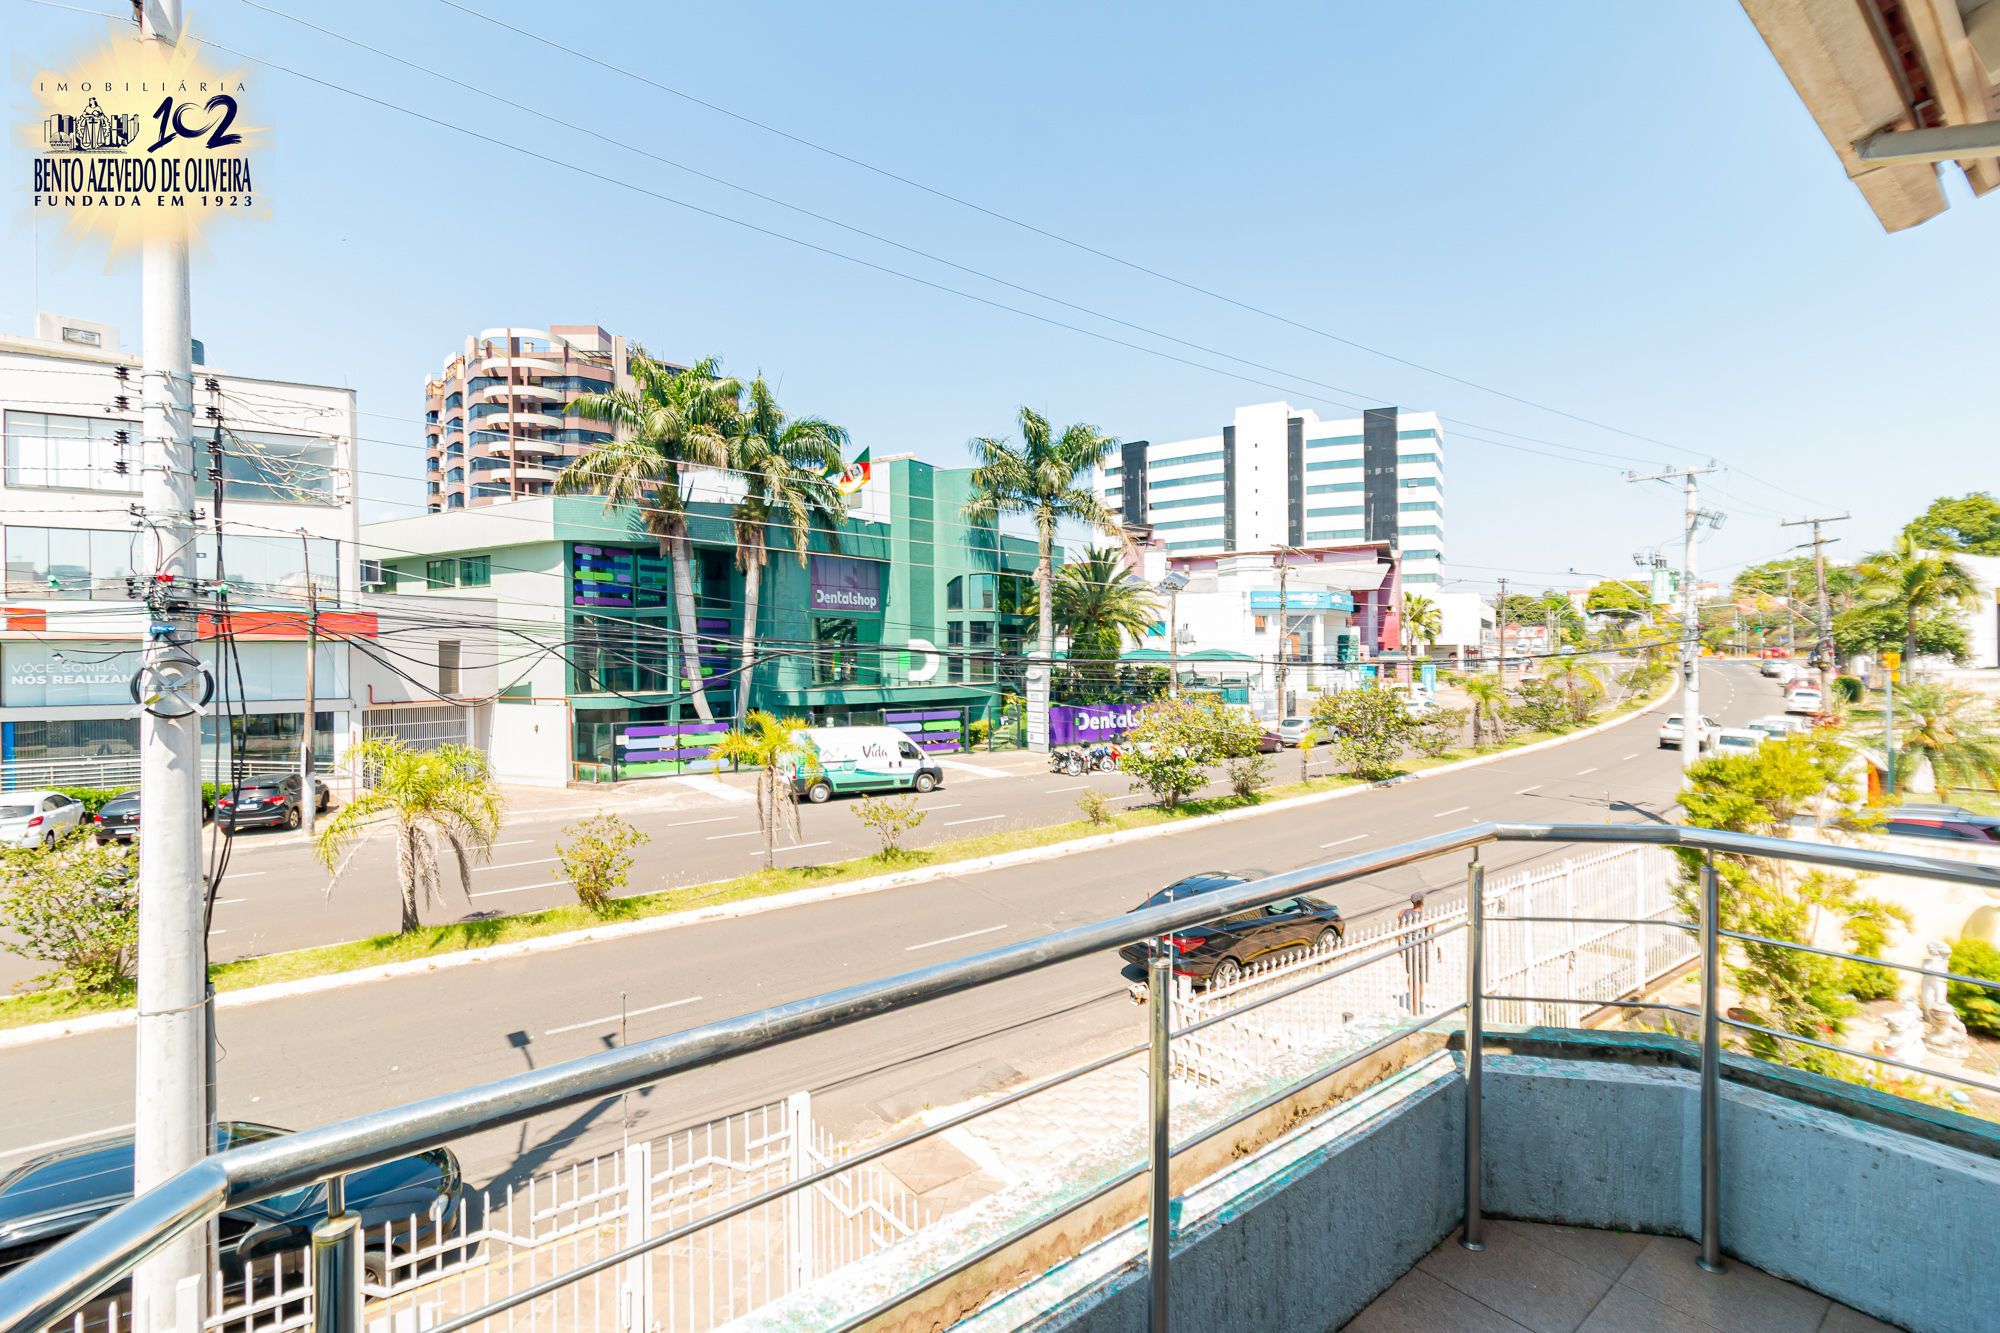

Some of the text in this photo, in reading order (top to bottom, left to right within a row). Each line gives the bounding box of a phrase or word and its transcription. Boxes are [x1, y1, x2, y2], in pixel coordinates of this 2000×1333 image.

[815, 589, 877, 609] Dentalshop
[11, 674, 48, 685] NÓS
[862, 743, 888, 759] Vida
